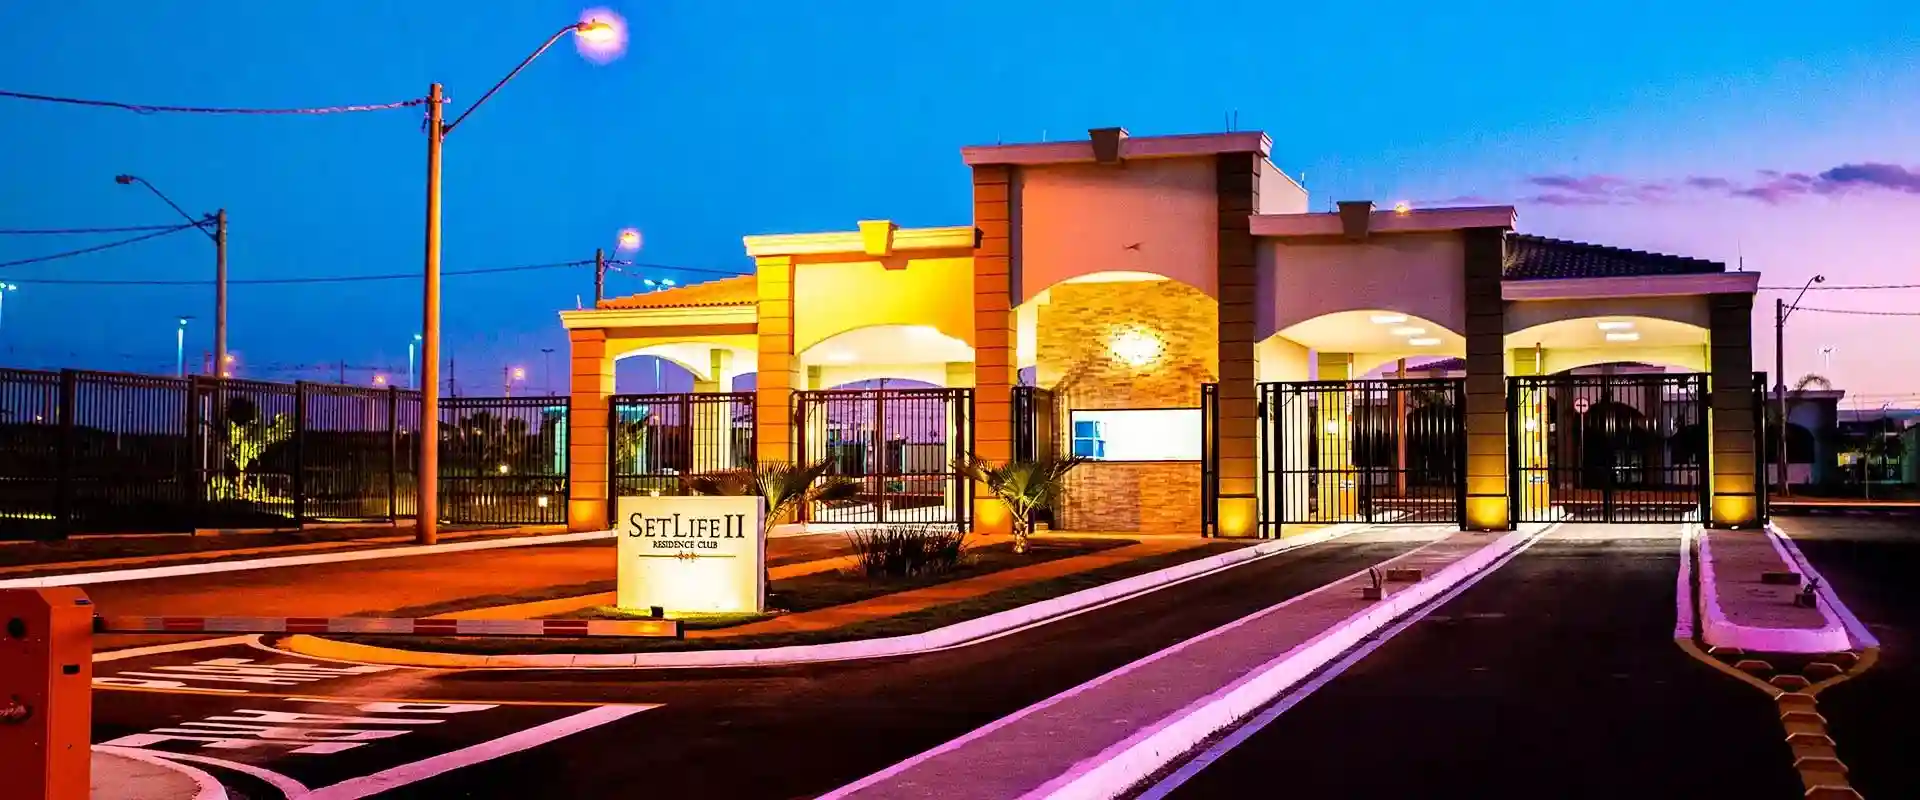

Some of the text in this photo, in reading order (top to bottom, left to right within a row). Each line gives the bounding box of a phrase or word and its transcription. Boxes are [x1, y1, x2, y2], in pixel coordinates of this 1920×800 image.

[653, 540, 718, 549] RESIDENCE CLUB
[100, 697, 501, 755] PARE
